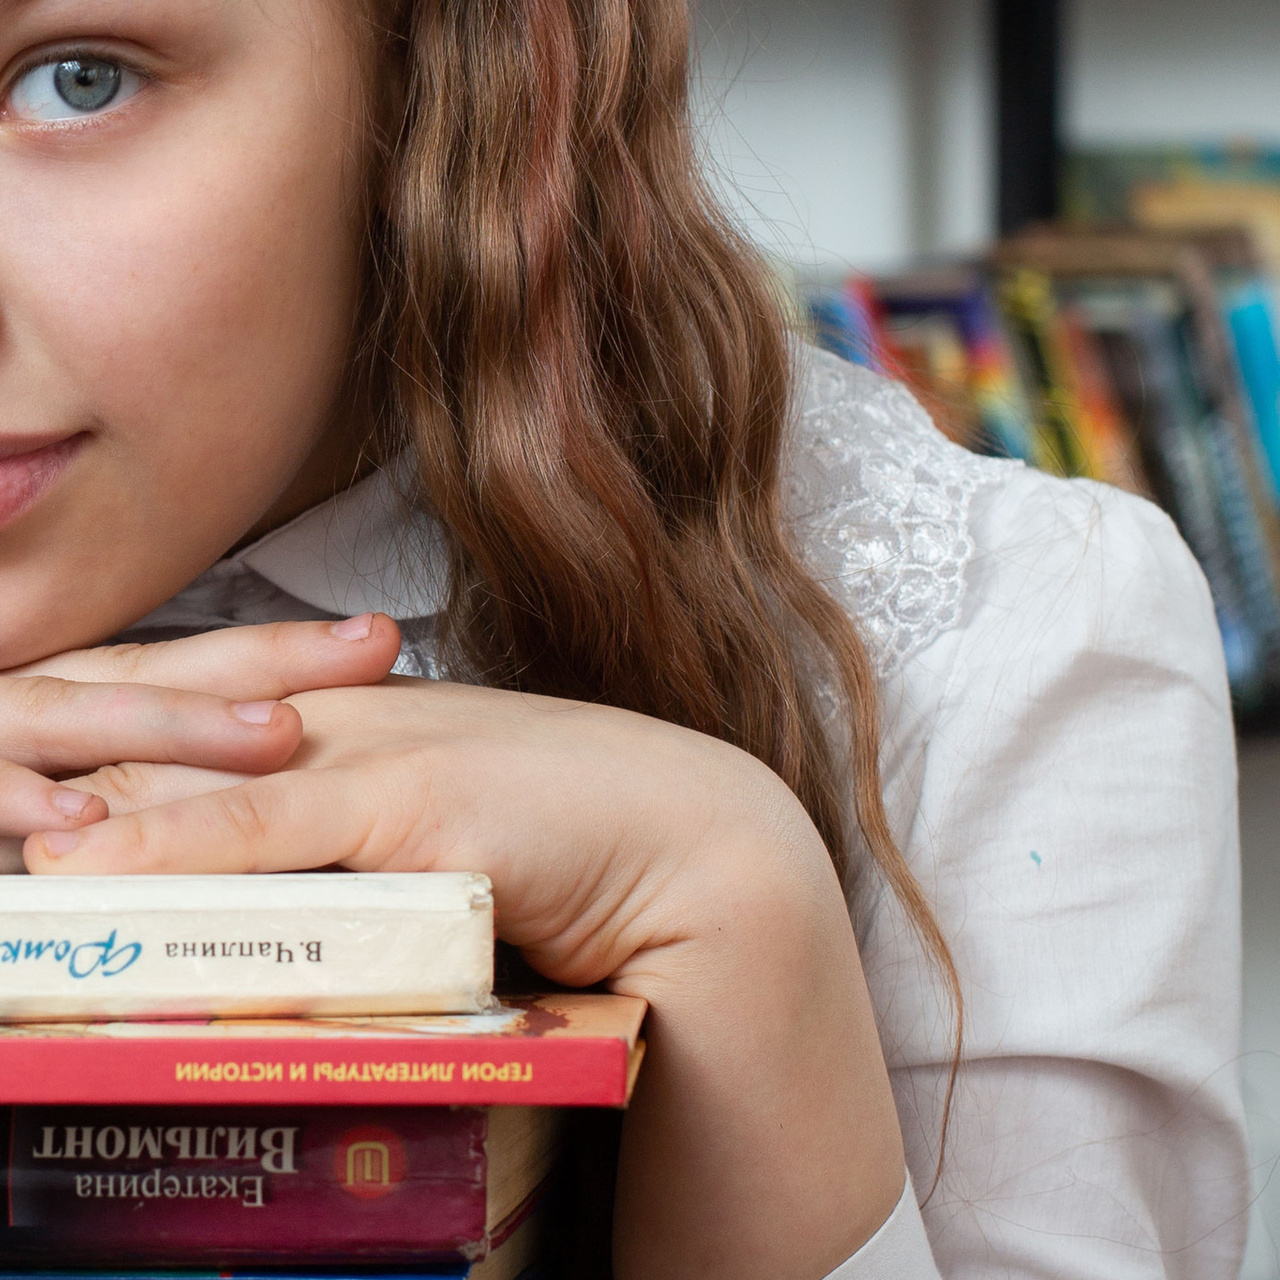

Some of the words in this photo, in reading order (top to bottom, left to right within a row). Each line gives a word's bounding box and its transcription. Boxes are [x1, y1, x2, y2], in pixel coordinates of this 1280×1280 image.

[175, 1061, 283, 1082] ИСТОРИИ
[289, 1061, 307, 1082] И
[313, 1061, 455, 1082] ЛИТЕРАТУРЫ
[461, 1061, 533, 1082] ГЕРОИ
[75, 1169, 266, 1208] Екатерина
